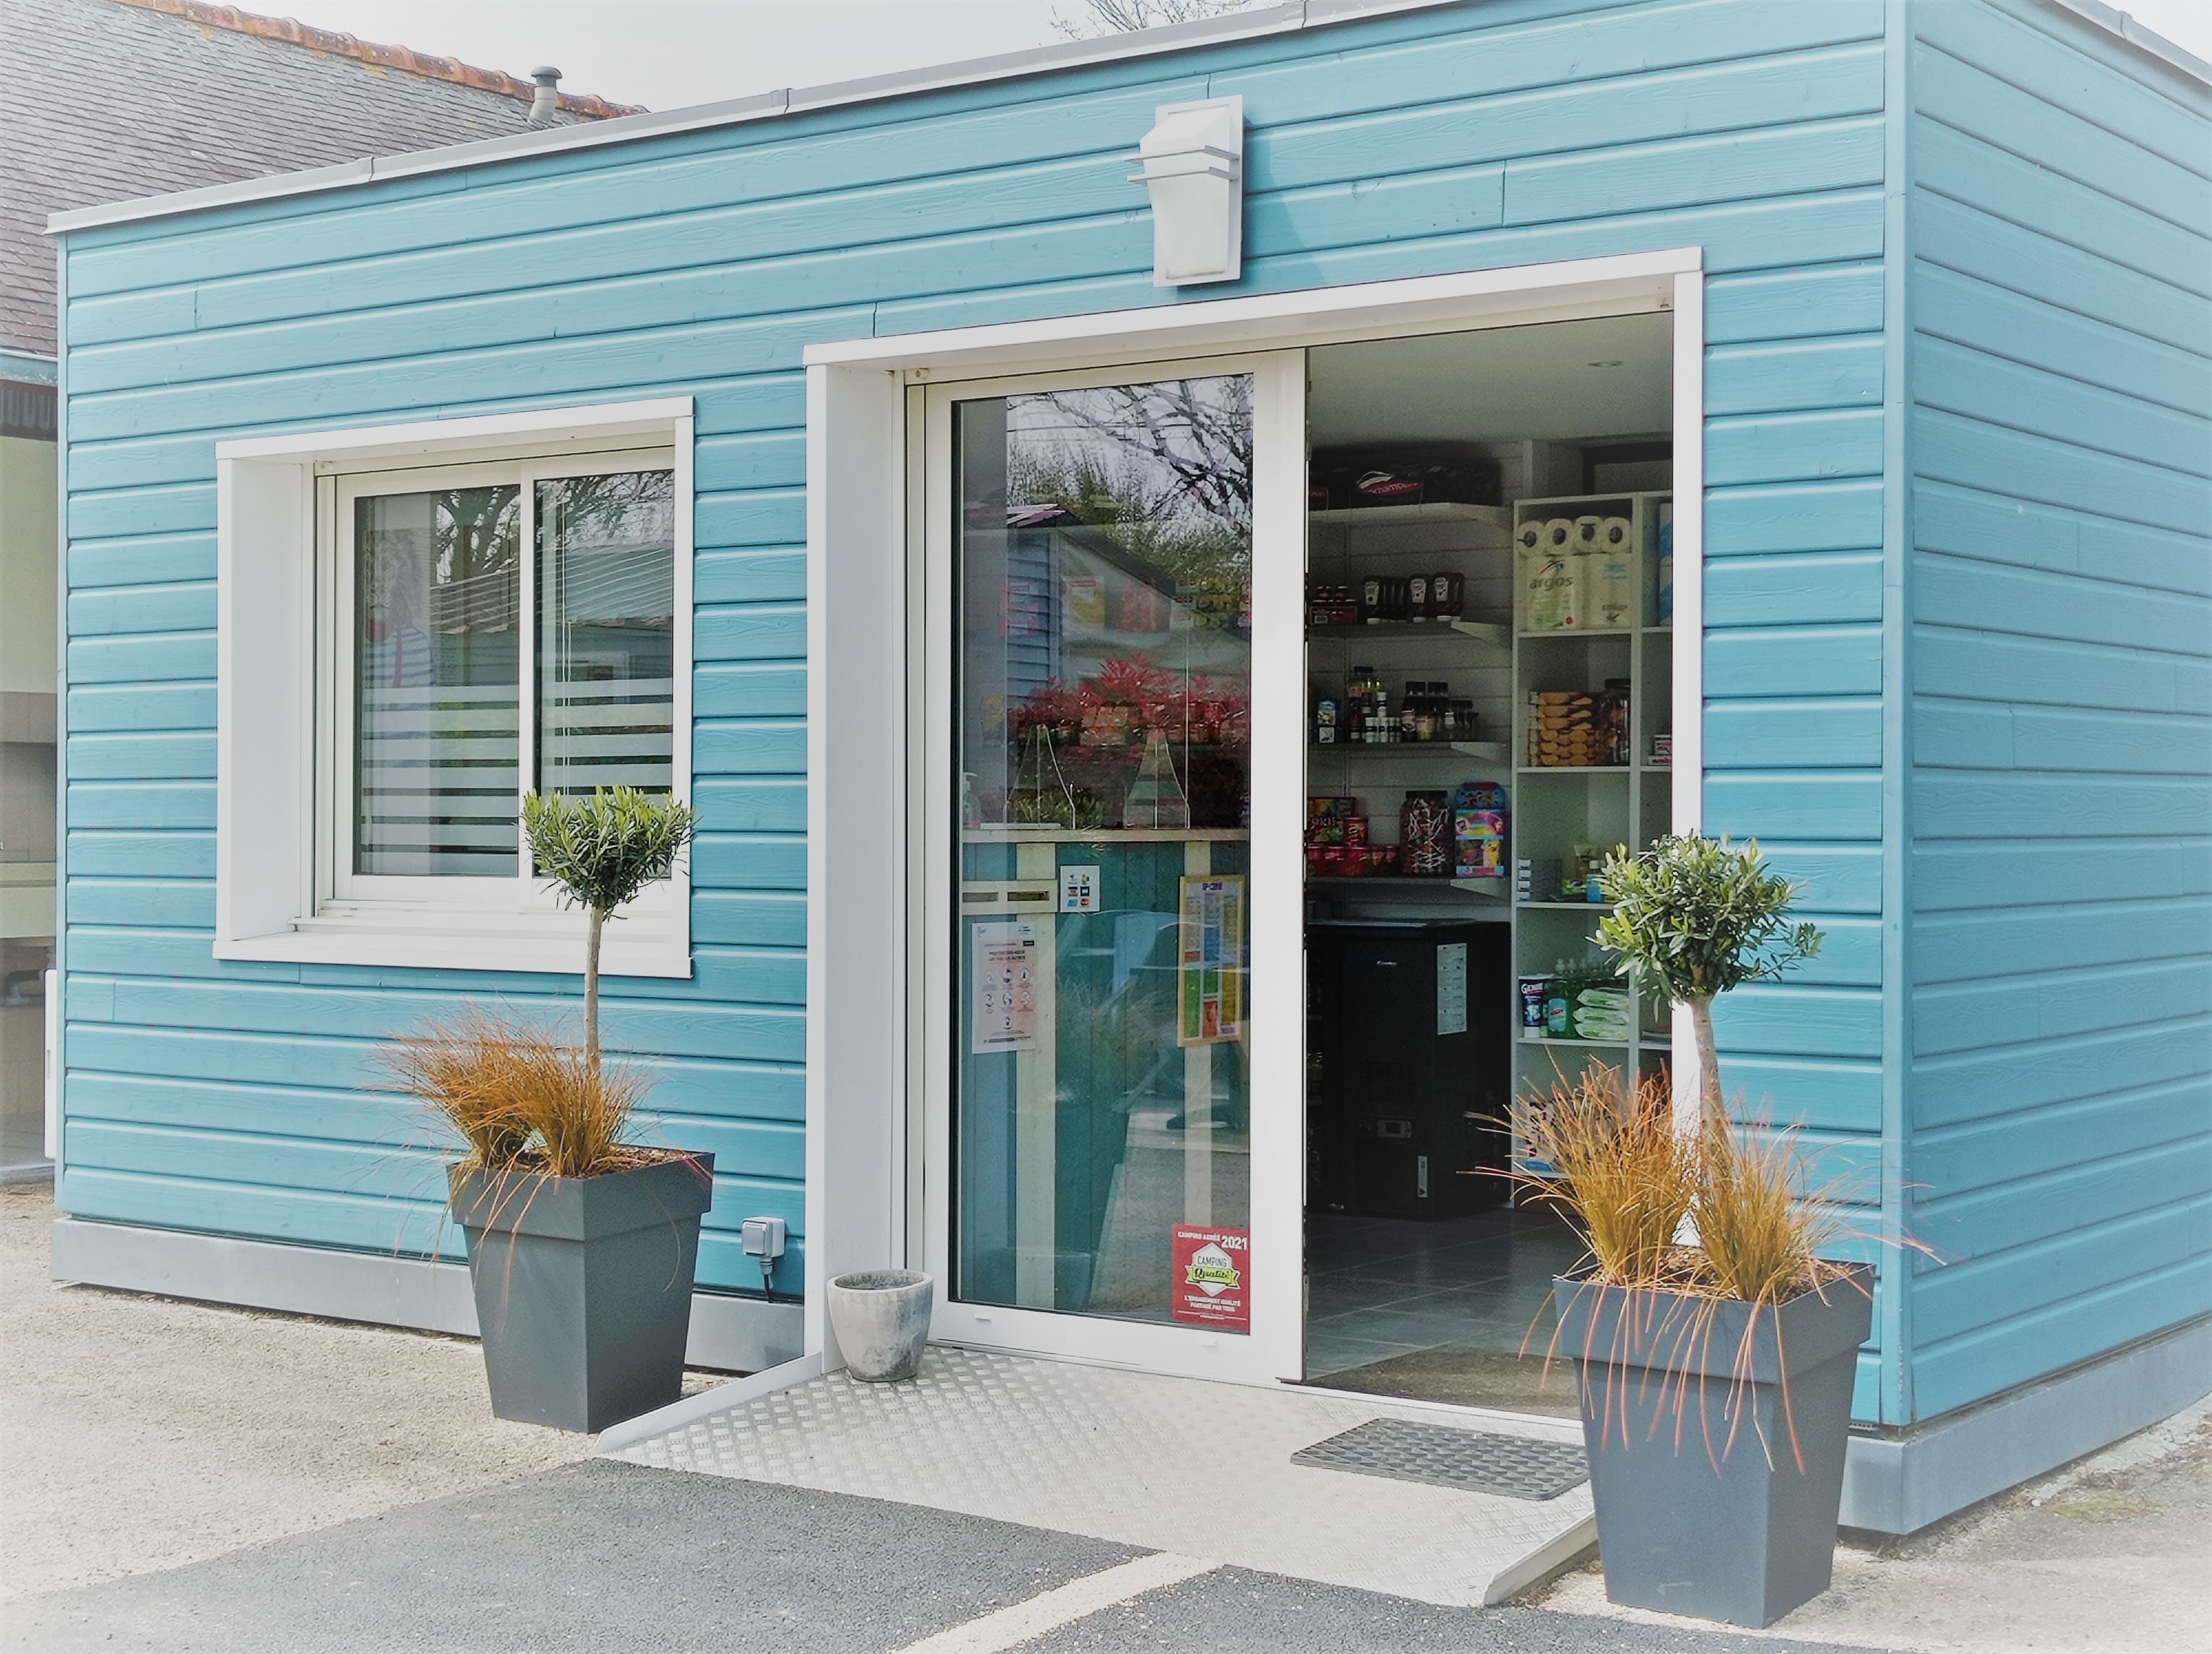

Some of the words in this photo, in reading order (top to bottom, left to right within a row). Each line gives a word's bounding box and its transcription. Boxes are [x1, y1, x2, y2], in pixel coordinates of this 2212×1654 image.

[1529, 576, 1573, 591] argos
[1221, 1236, 1248, 1250] 2021
[1197, 1255, 1228, 1267] CAMPING
[1194, 1268, 1230, 1279] Qualité
